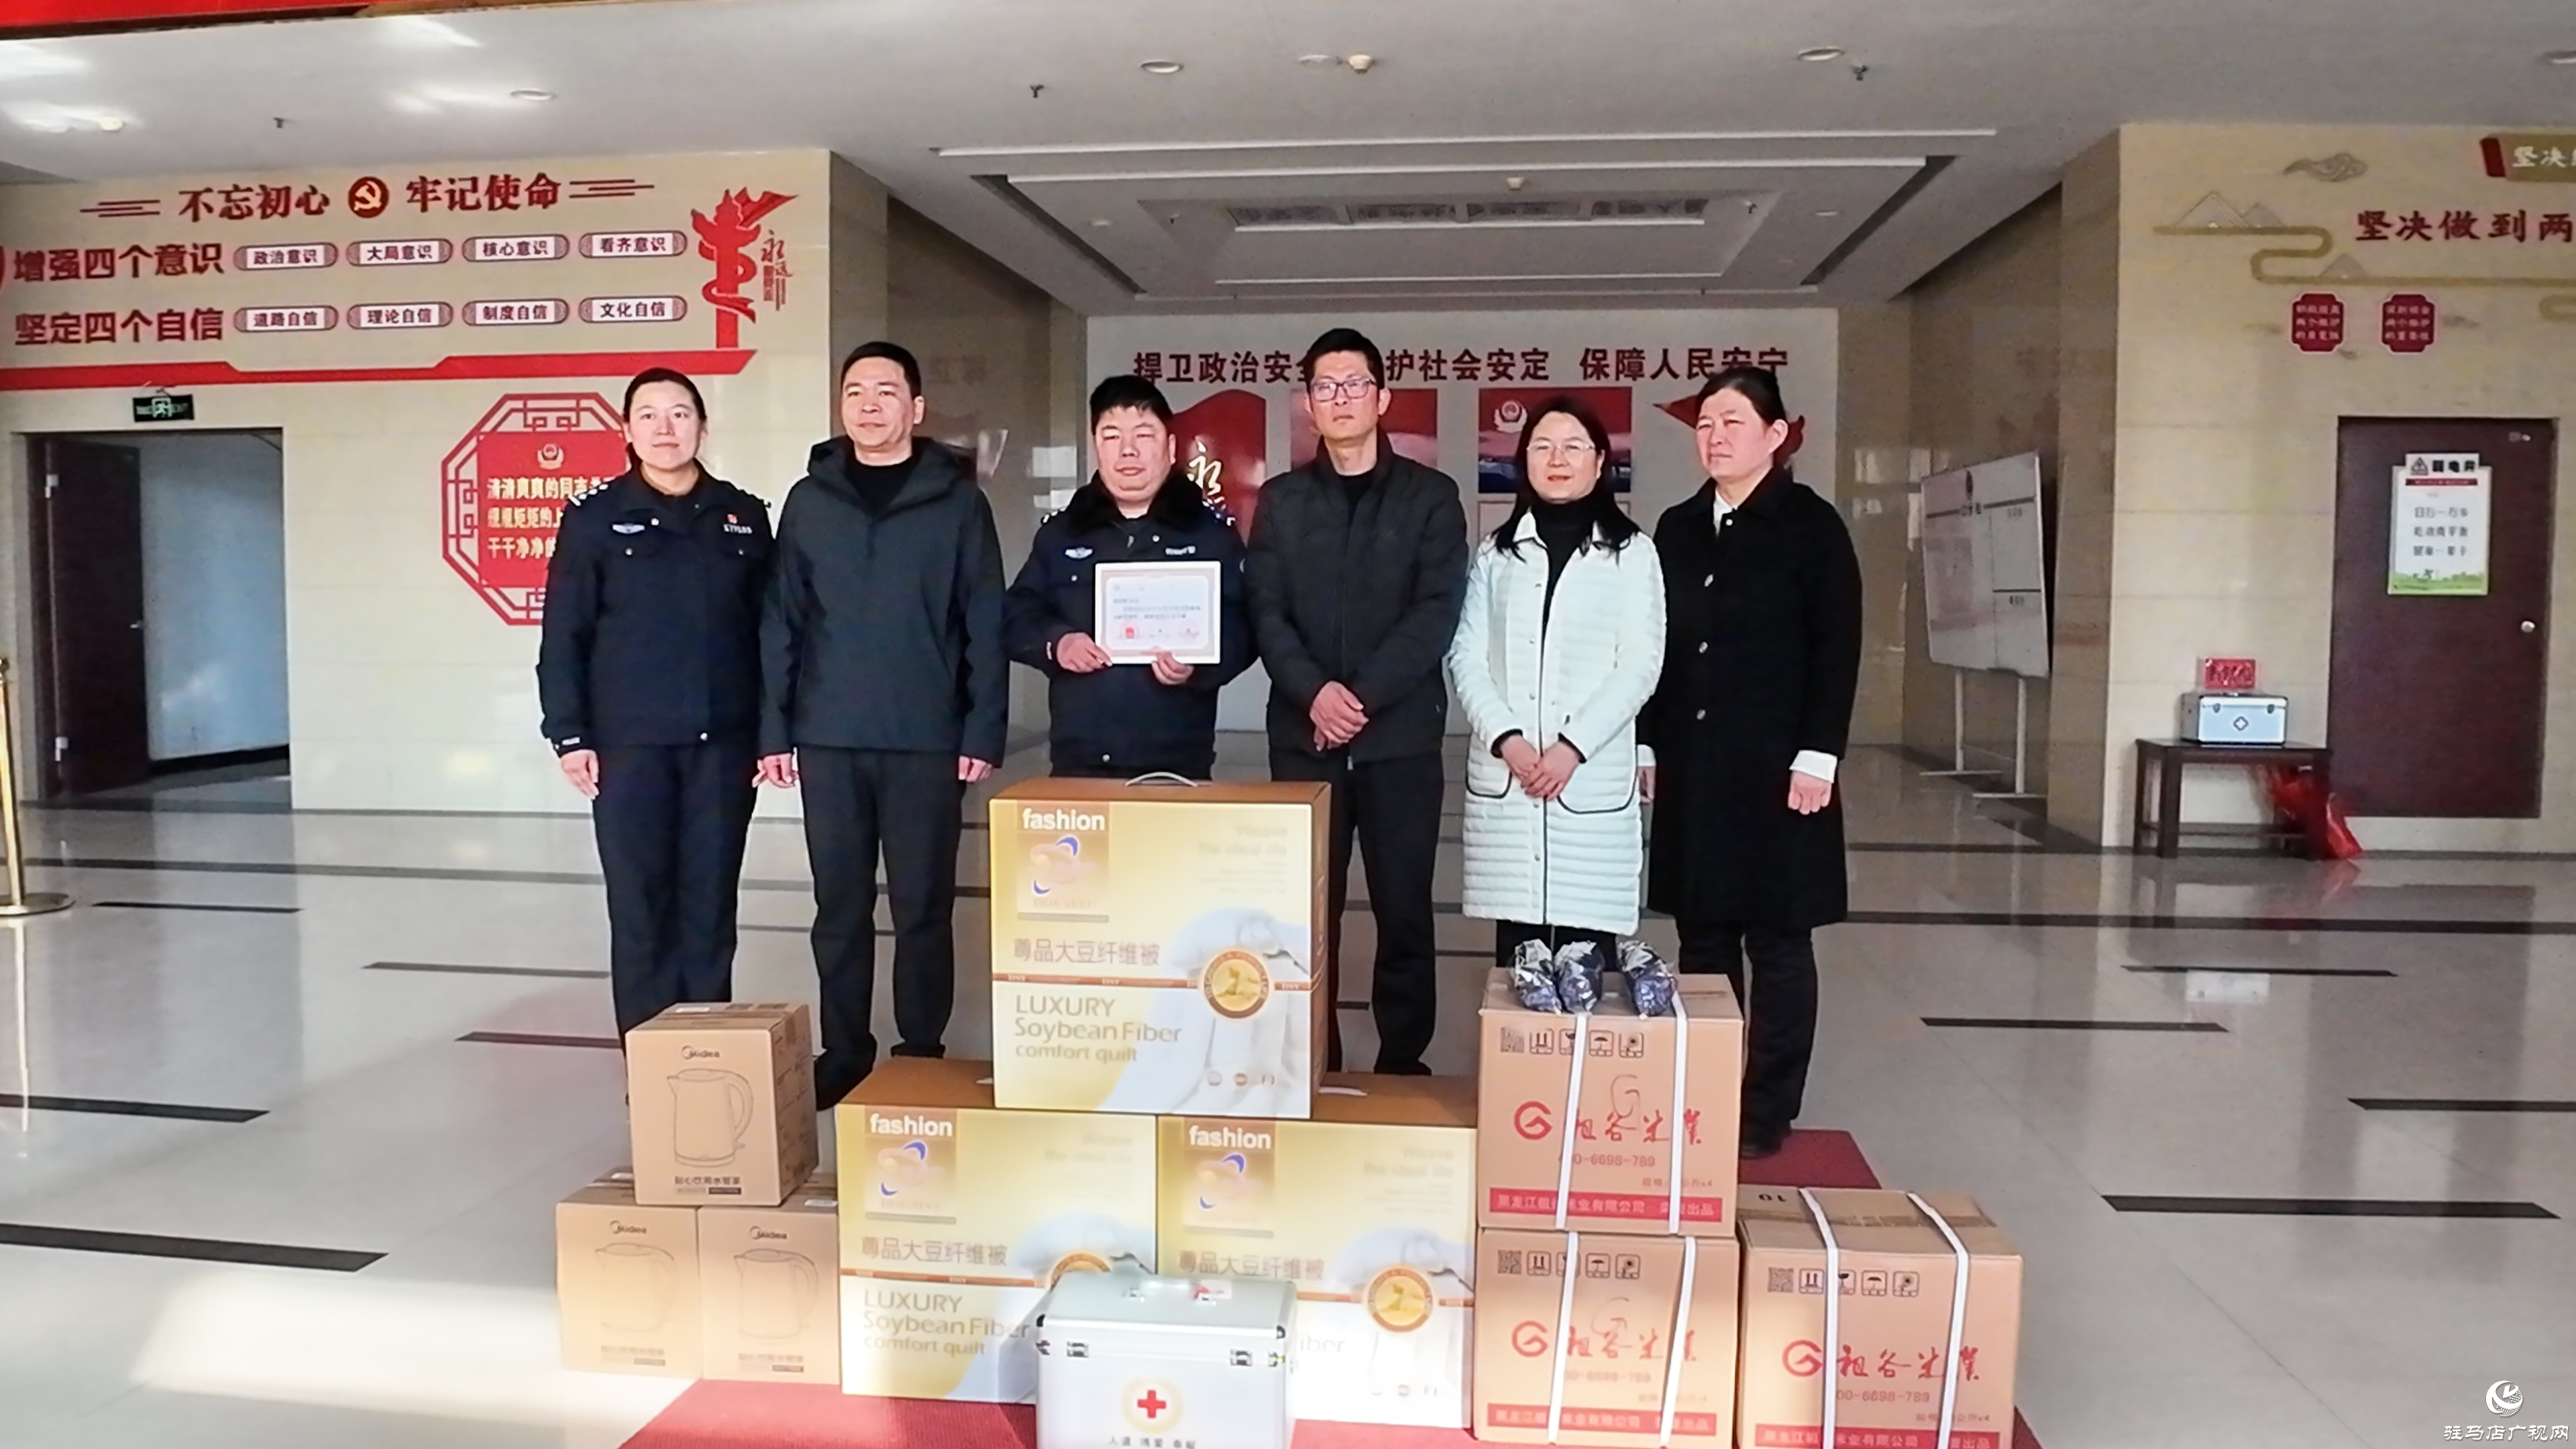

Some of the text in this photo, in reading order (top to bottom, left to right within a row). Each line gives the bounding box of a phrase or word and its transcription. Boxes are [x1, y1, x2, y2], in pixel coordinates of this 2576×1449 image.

[2512, 146, 2576, 168] 坚决
[178, 172, 561, 223] 不忘初心 牢记使命
[2356, 209, 2572, 244] 坚决做到两
[253, 248, 317, 264] 政治意识
[368, 244, 433, 261] 大局意识
[483, 240, 547, 257] 核心意识
[600, 237, 666, 253] 看齐意识
[13, 242, 224, 282] 增强四个意识
[253, 311, 318, 327] 道路自信
[368, 308, 432, 325] 理论自信
[483, 305, 547, 321] 制度自信
[600, 302, 666, 318] 文化自信
[15, 308, 224, 345] 坚定四个自信
[1134, 351, 1307, 384] 捍卫政治安
[1386, 347, 1550, 382] 护社会安定
[1022, 808, 1106, 831] fashion
[1016, 995, 1116, 1017] LUXURY
[1014, 1018, 1182, 1044] Soybean Fiber
[681, 1044, 720, 1060] Midea
[1016, 1044, 1138, 1064] comfort quilt
[869, 1113, 953, 1137] fashion
[1189, 1125, 1272, 1150] fashion
[749, 1225, 788, 1241] Midea
[864, 1289, 963, 1313] LUXURY
[863, 1310, 1030, 1338] Soybean Fiber
[864, 1334, 985, 1357] comfort quilt
[1299, 1333, 1346, 1354] iber
